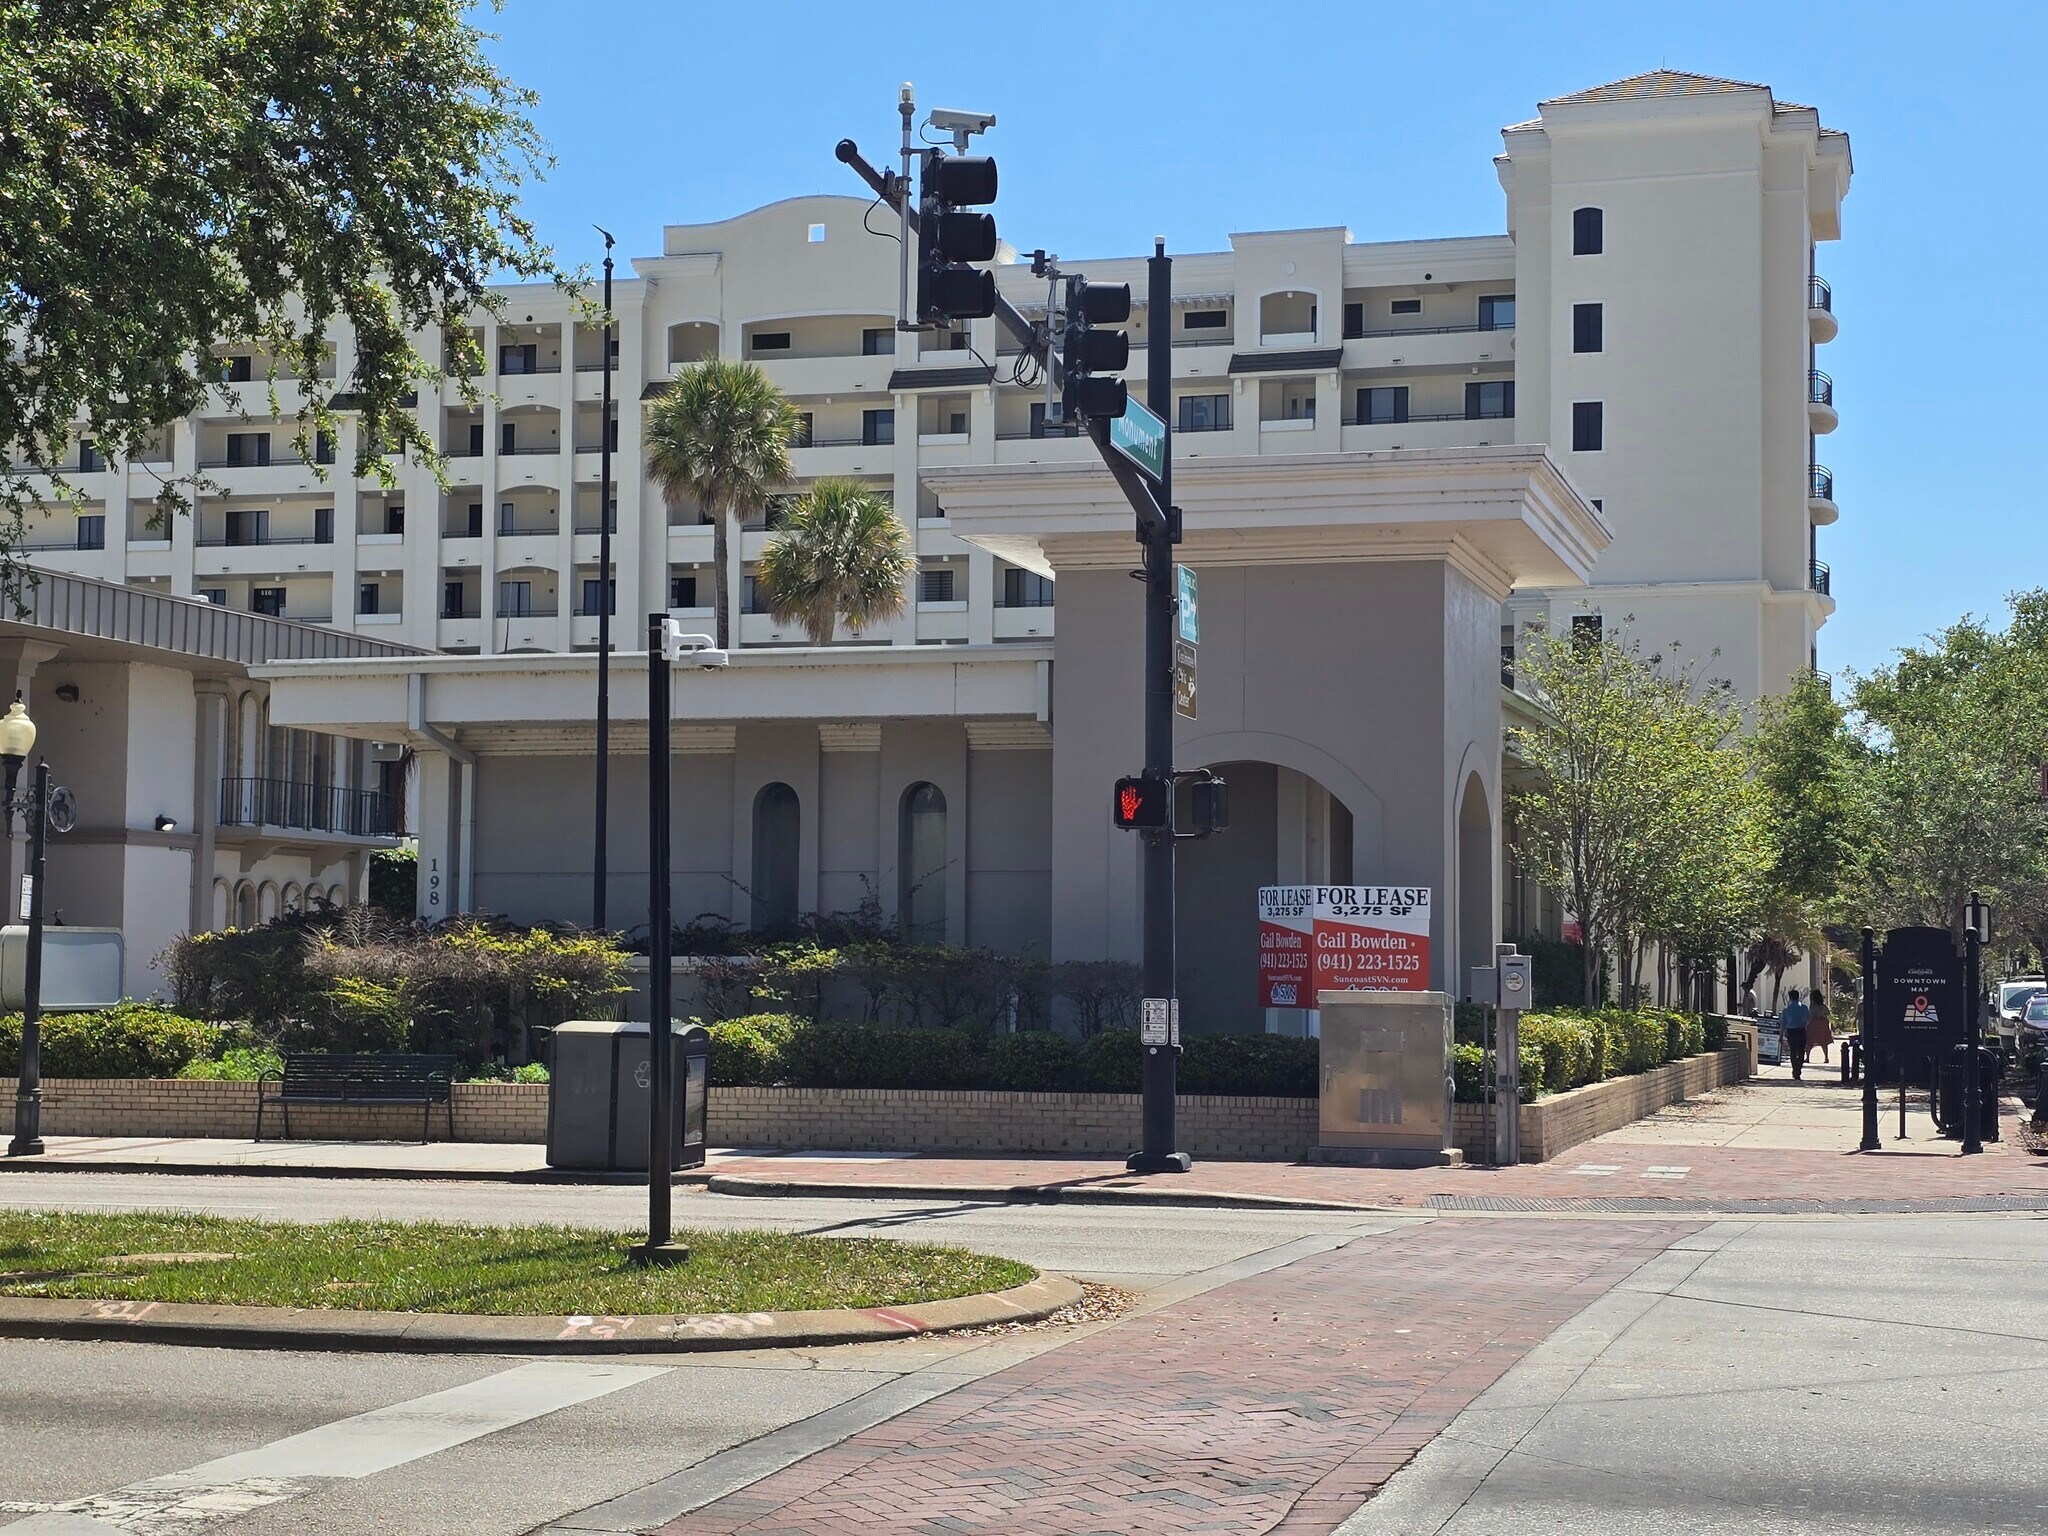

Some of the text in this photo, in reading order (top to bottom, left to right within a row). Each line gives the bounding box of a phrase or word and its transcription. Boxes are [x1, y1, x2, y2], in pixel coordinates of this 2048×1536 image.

[1118, 417, 1158, 460] Monument
[430, 858, 440, 906] 198
[1260, 889, 1312, 907] FOR LEASE
[1316, 887, 1429, 907] FOR LEASE
[1267, 907, 1304, 918] 3,275 SF
[1332, 906, 1412, 918] 3,275 SF
[1260, 932, 1302, 949] Gail Bowden
[1317, 932, 1408, 950] Gail Bowden
[1260, 953, 1308, 970] (941) 223-1525
[1317, 953, 1420, 972] (941) 223-1525
[1333, 975, 1409, 984] SuncoastSVN.com
